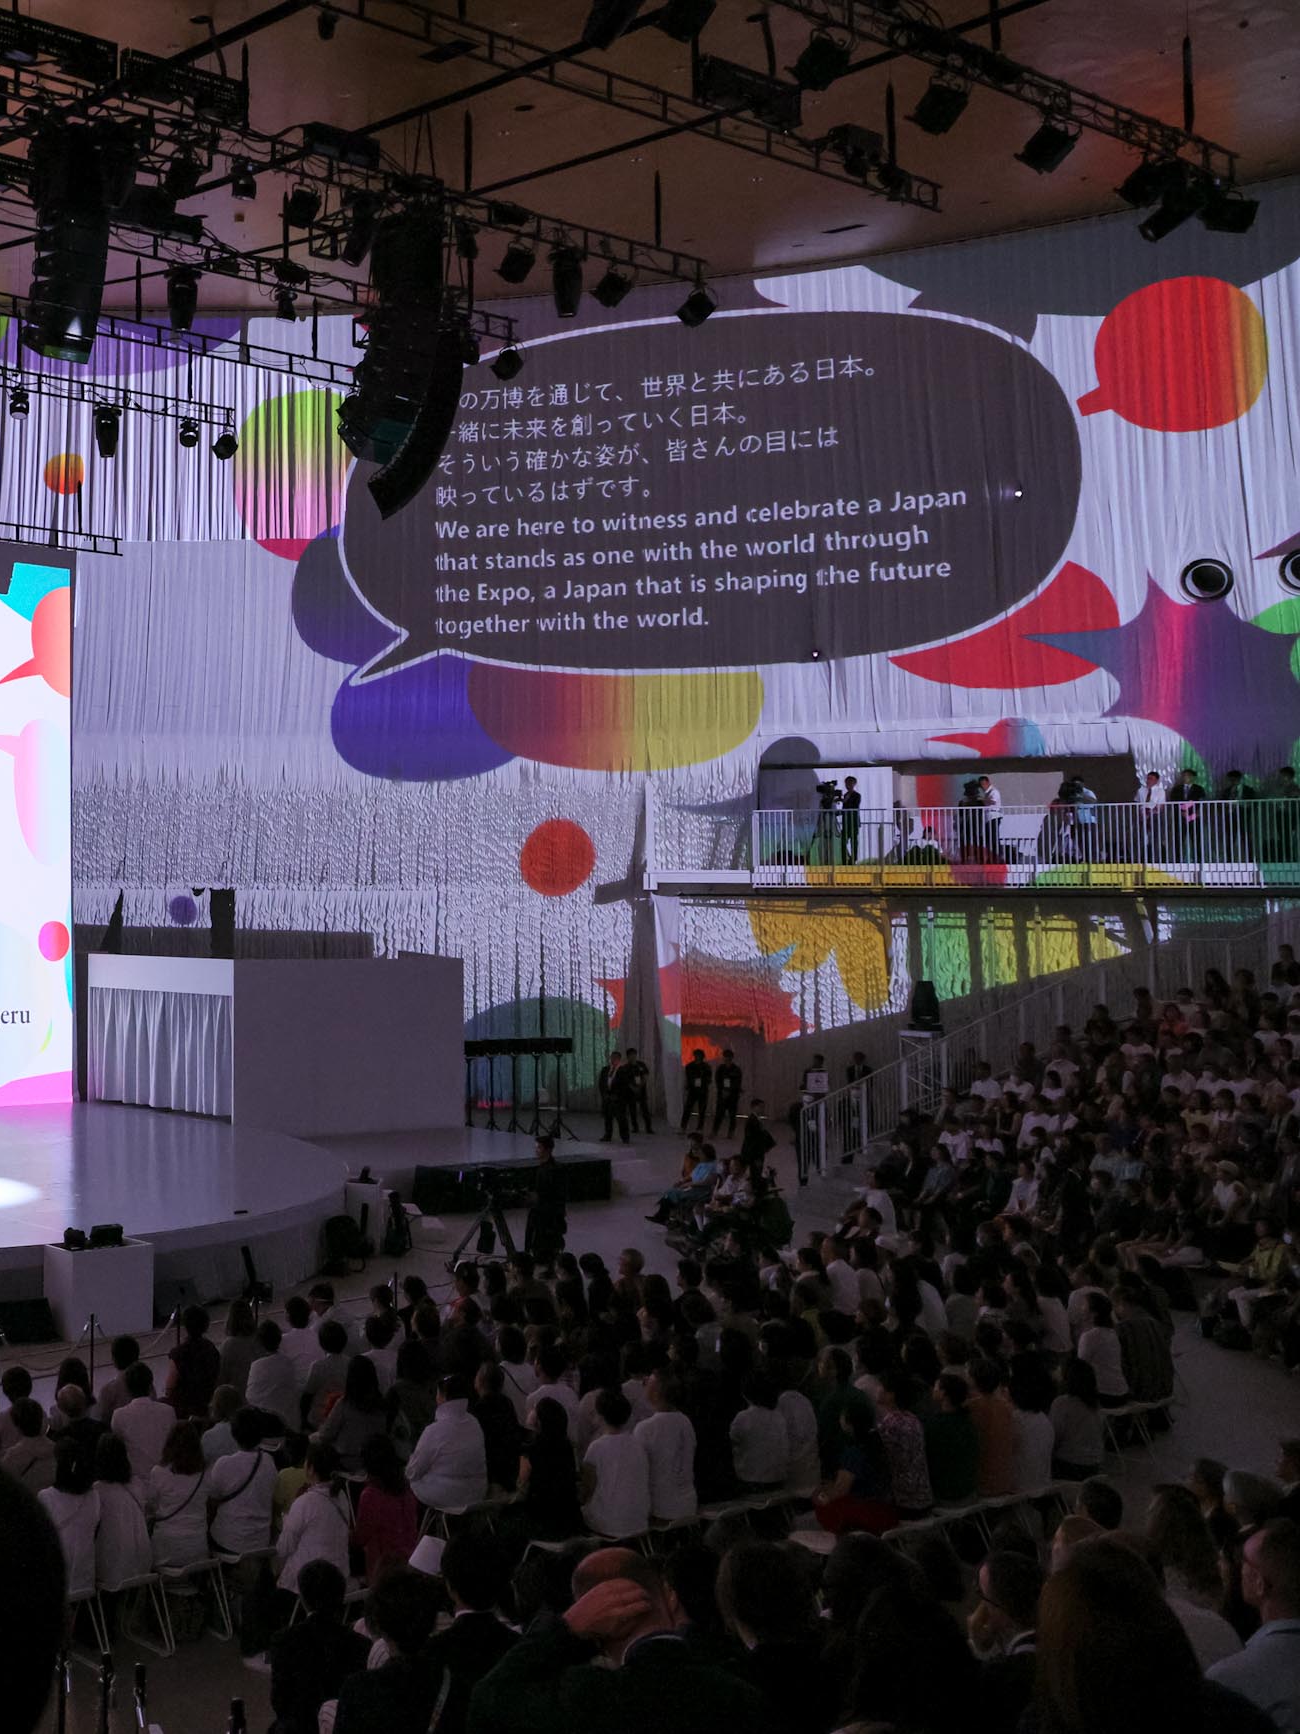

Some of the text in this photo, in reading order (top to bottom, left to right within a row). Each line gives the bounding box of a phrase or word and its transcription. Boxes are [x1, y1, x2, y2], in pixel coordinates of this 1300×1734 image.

[450, 401, 747, 443] 緒に未来を創っていく日本。
[436, 476, 651, 507] 映っているはずです。
[436, 490, 967, 538] We are here to witness and celebrate a Japan
[436, 525, 929, 571] that stands as one with the world through
[436, 560, 952, 606] the Expo, a Japan that is shaping the future
[436, 606, 709, 639] together with the world.
